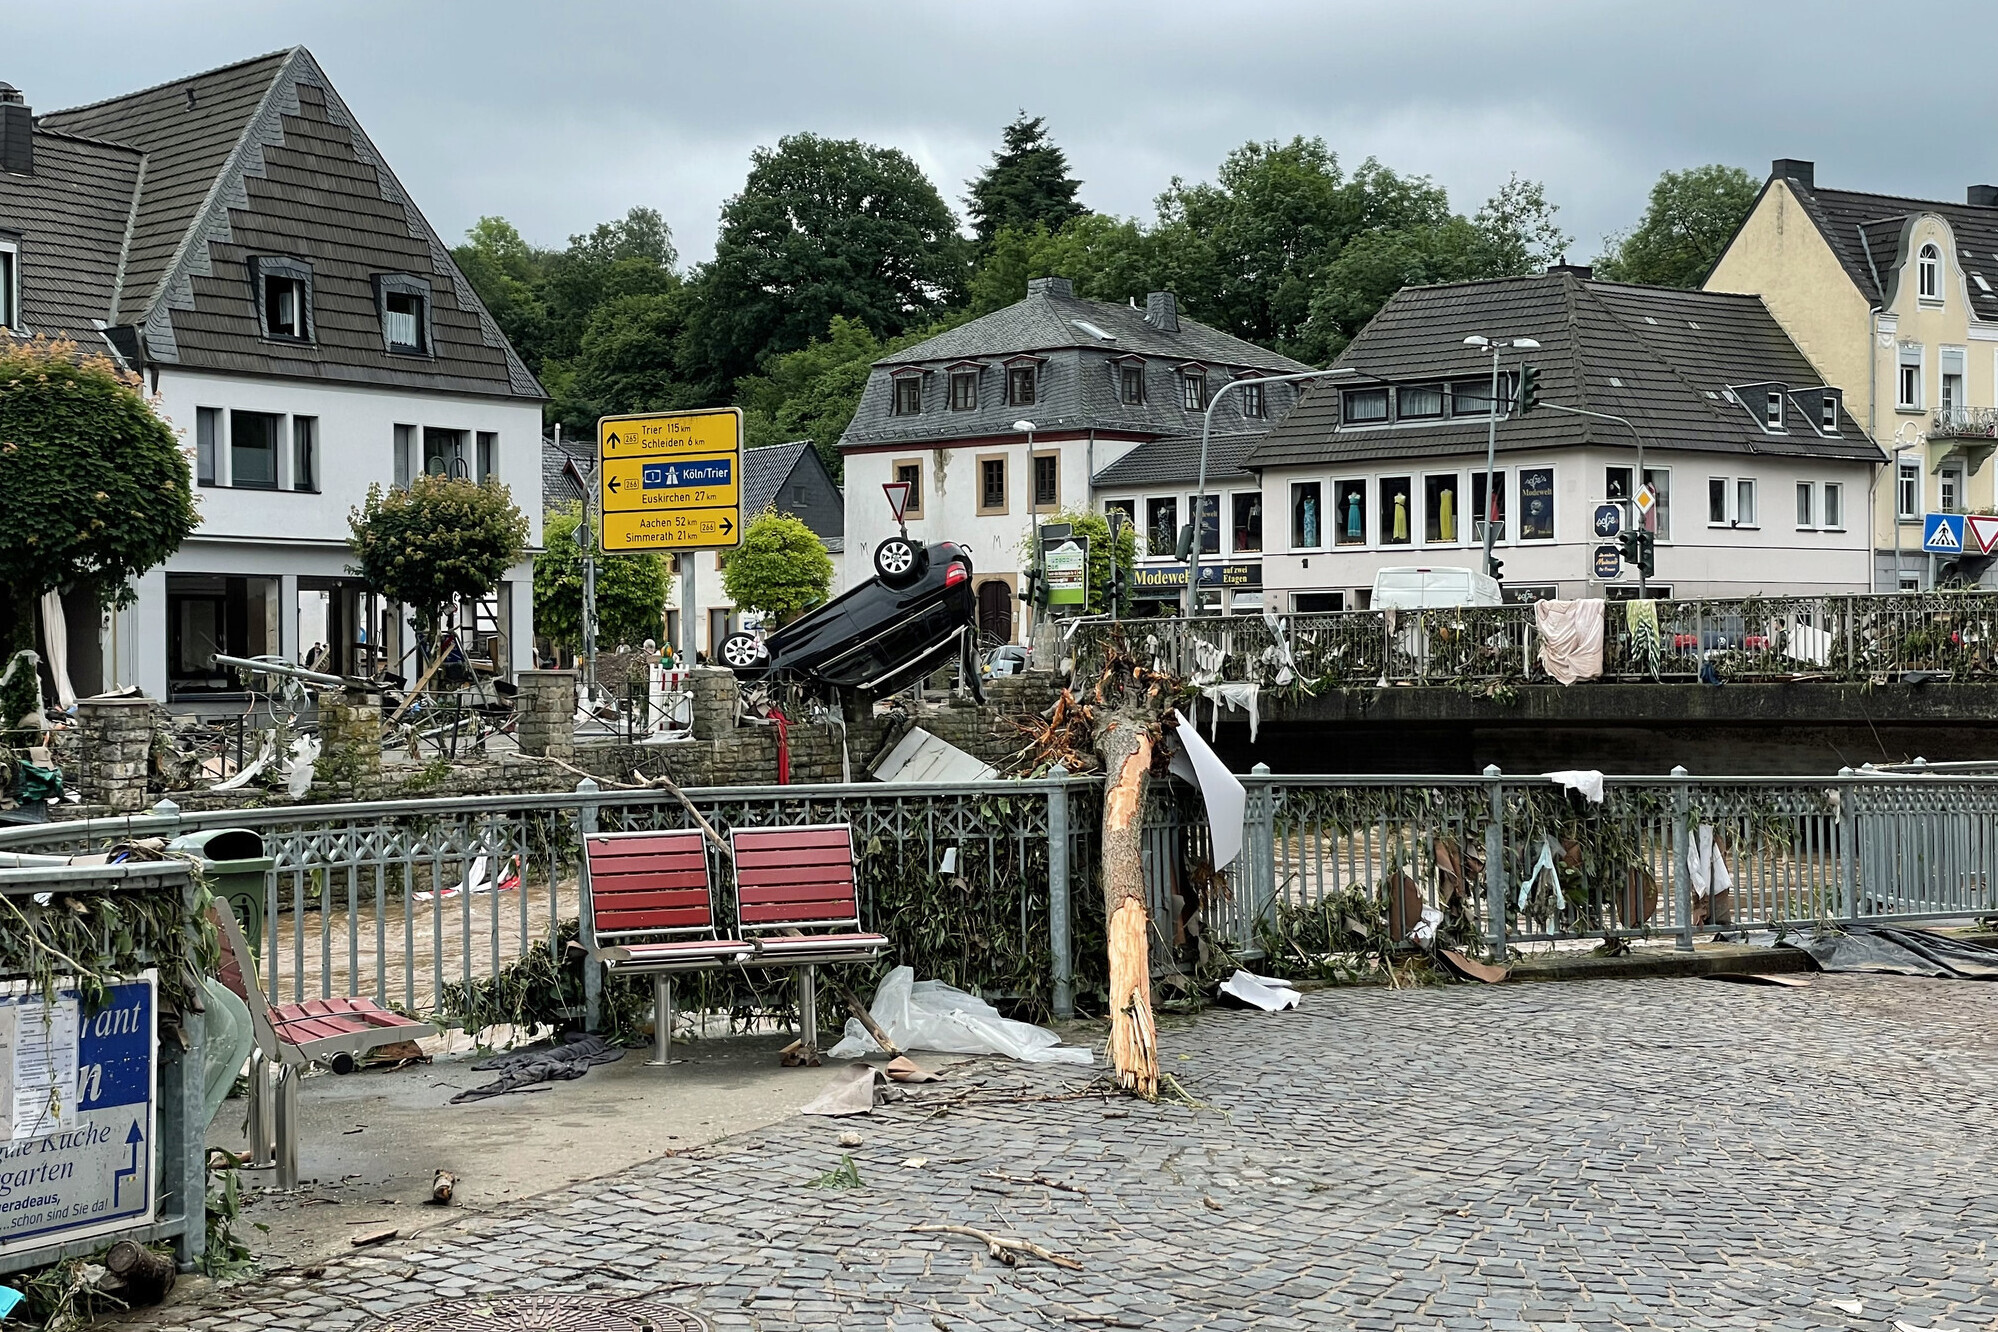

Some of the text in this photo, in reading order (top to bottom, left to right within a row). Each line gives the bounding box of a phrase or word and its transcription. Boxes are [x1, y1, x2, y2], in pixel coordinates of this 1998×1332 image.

[642, 425, 662, 435] Trier
[667, 423, 679, 433] 115
[625, 435, 637, 443] 265
[642, 438, 684, 449] Schleiden
[688, 436, 693, 446] 6
[683, 468, 729, 480] Köln/Trier
[626, 481, 638, 489] 266
[642, 492, 690, 504] Euskirchen
[695, 491, 705, 501] 27
[640, 518, 672, 528] Aachen
[675, 517, 686, 527] 52
[702, 523, 713, 531] 266
[626, 531, 673, 543] Simmerath
[678, 530, 686, 540] 21
[1134, 569, 1190, 585] Modewel
[1223, 574, 1248, 584] Etagen
[79, 1001, 141, 1038] rant
[0, 1194, 60, 1213] eradeaus,
[47, 1205, 69, 1221] sind
[72, 1203, 88, 1216] Sie
[92, 1198, 108, 1212] da!
